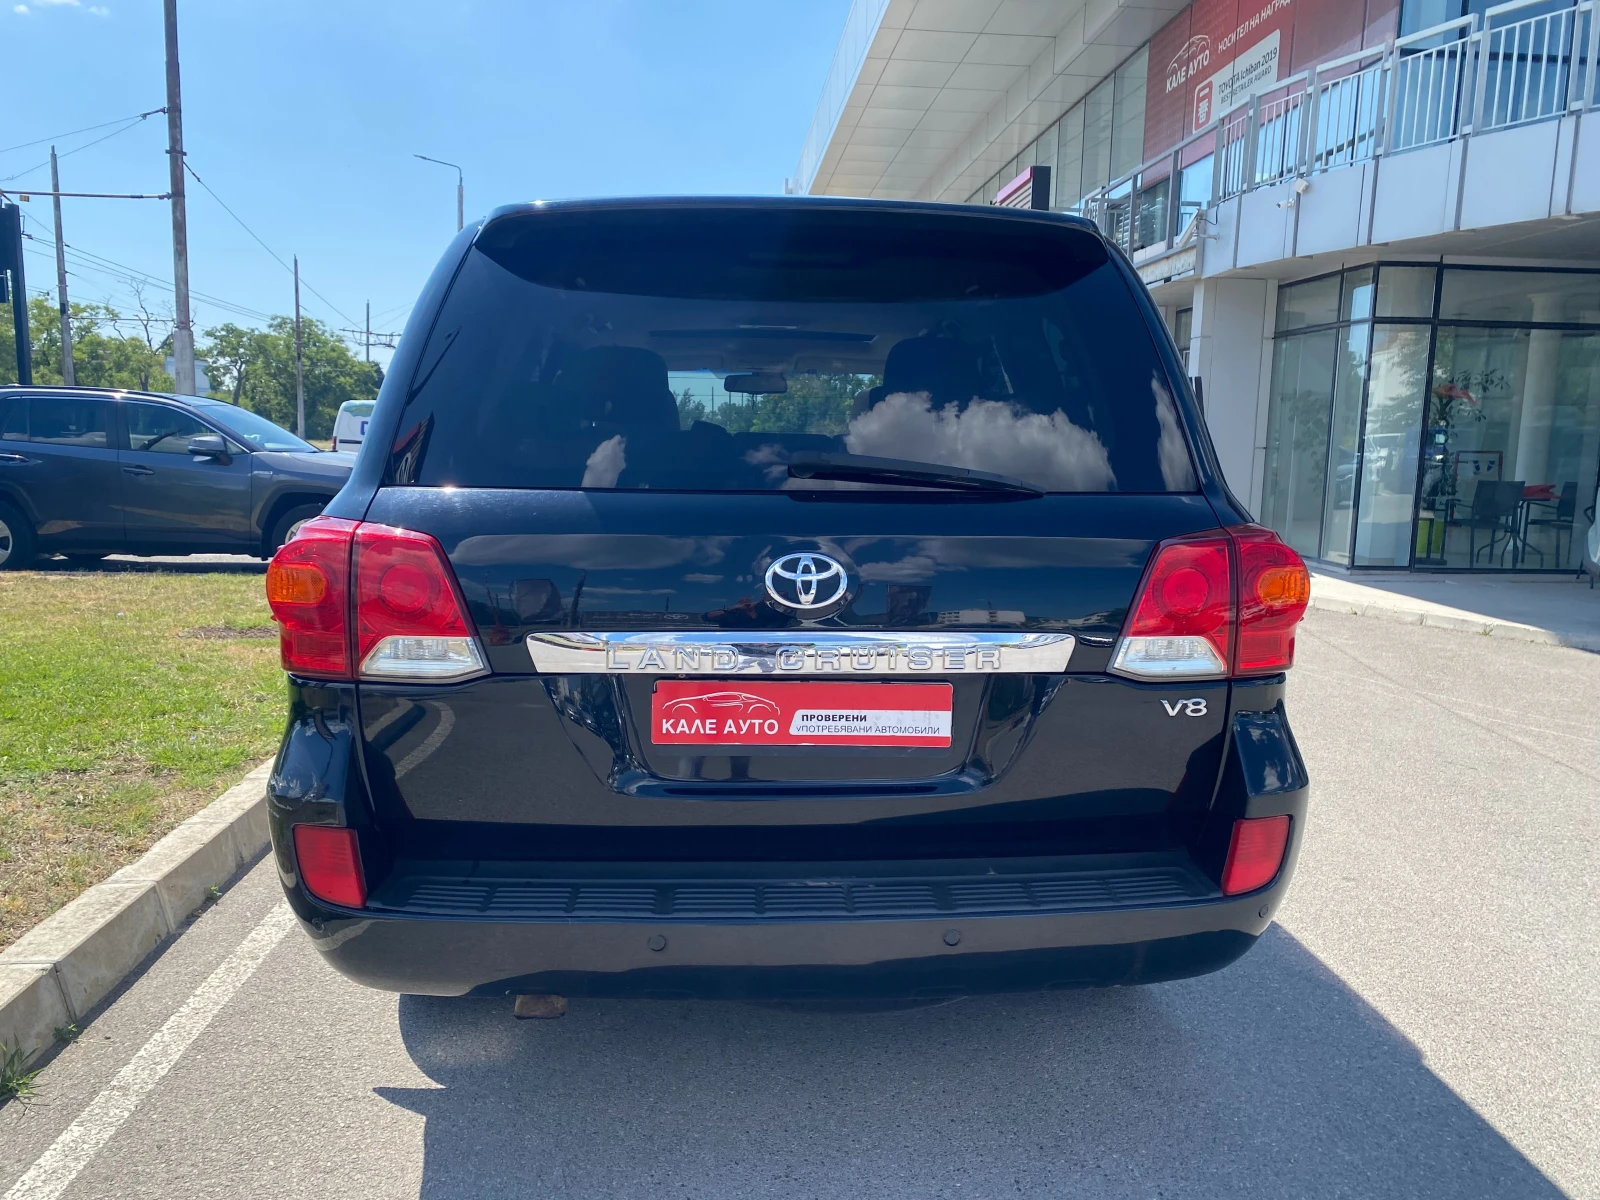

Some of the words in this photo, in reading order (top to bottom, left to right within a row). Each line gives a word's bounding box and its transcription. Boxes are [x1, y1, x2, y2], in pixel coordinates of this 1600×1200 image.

[1249, 16, 1260, 31] НА
[1166, 66, 1186, 94] КАЛЕ
[1187, 49, 1210, 78] АУТО
[1218, 72, 1240, 95] TOYOTA
[1240, 60, 1261, 81] Ichiban
[1261, 46, 1278, 67] 2019
[1220, 91, 1232, 105] BEST
[1253, 65, 1272, 84] AWARD
[606, 646, 739, 671] LAND
[776, 645, 1003, 671] CRUISER
[1160, 698, 1208, 717] V8
[662, 719, 717, 735] КАЛЕ
[723, 719, 779, 735] АУТО
[801, 713, 868, 723] ПРОВЕРЕНИ
[796, 725, 874, 735] УПОТРЕБЯВАНИ
[874, 725, 941, 736] АВТОМОБИЛИ
